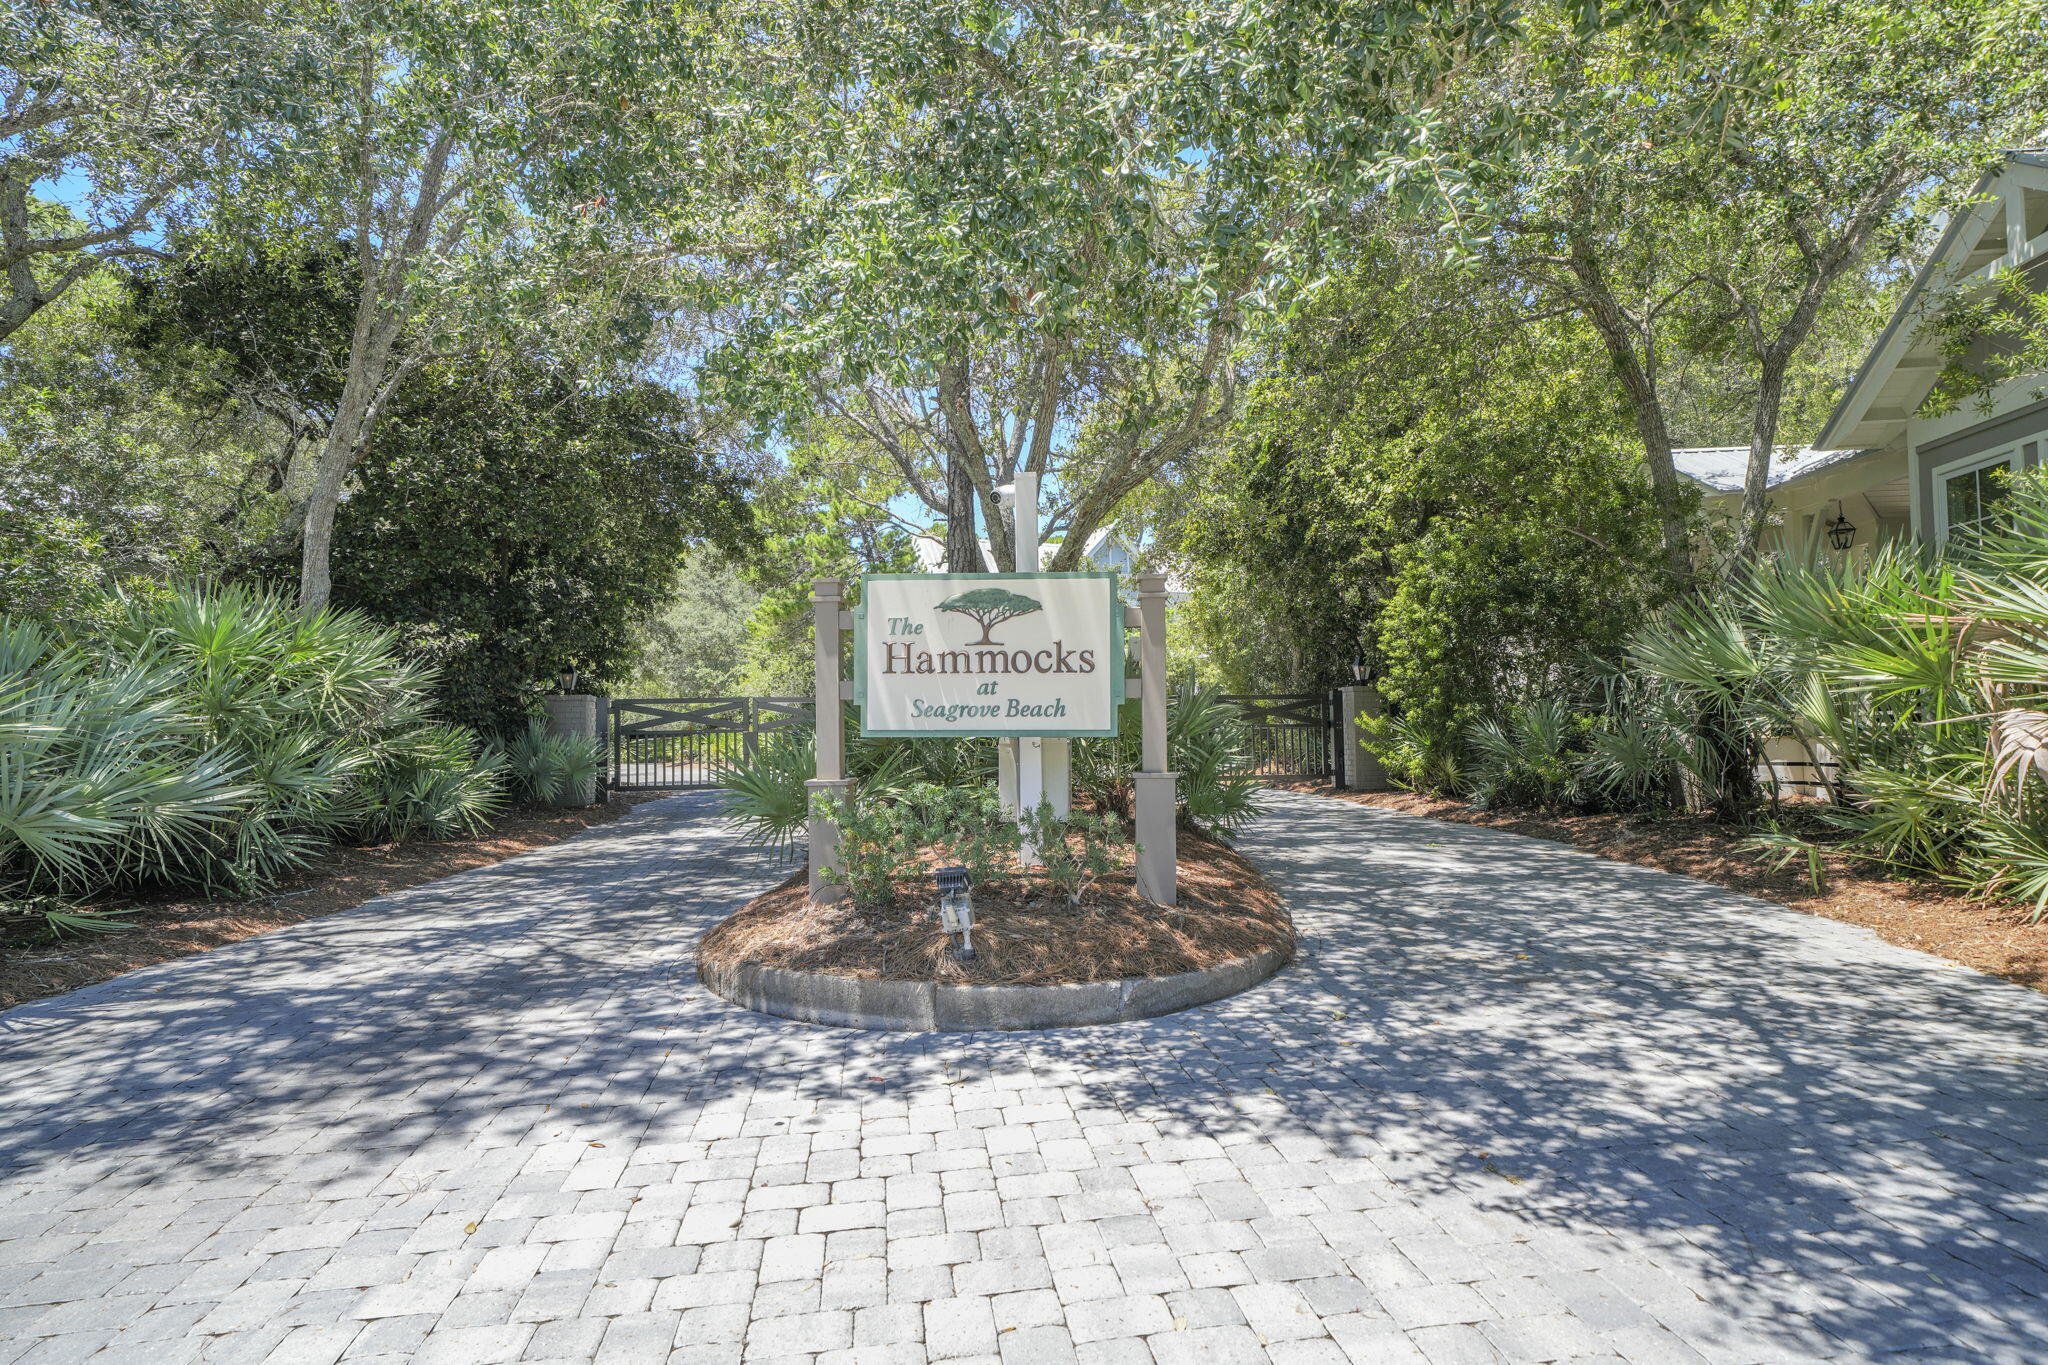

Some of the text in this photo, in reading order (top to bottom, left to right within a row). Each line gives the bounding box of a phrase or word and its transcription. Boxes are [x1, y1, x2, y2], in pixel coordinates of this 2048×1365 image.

[888, 616, 924, 636] The
[882, 640, 1096, 675] Hammocks
[976, 680, 998, 696] at
[911, 698, 1066, 722] Seagrove Beach
